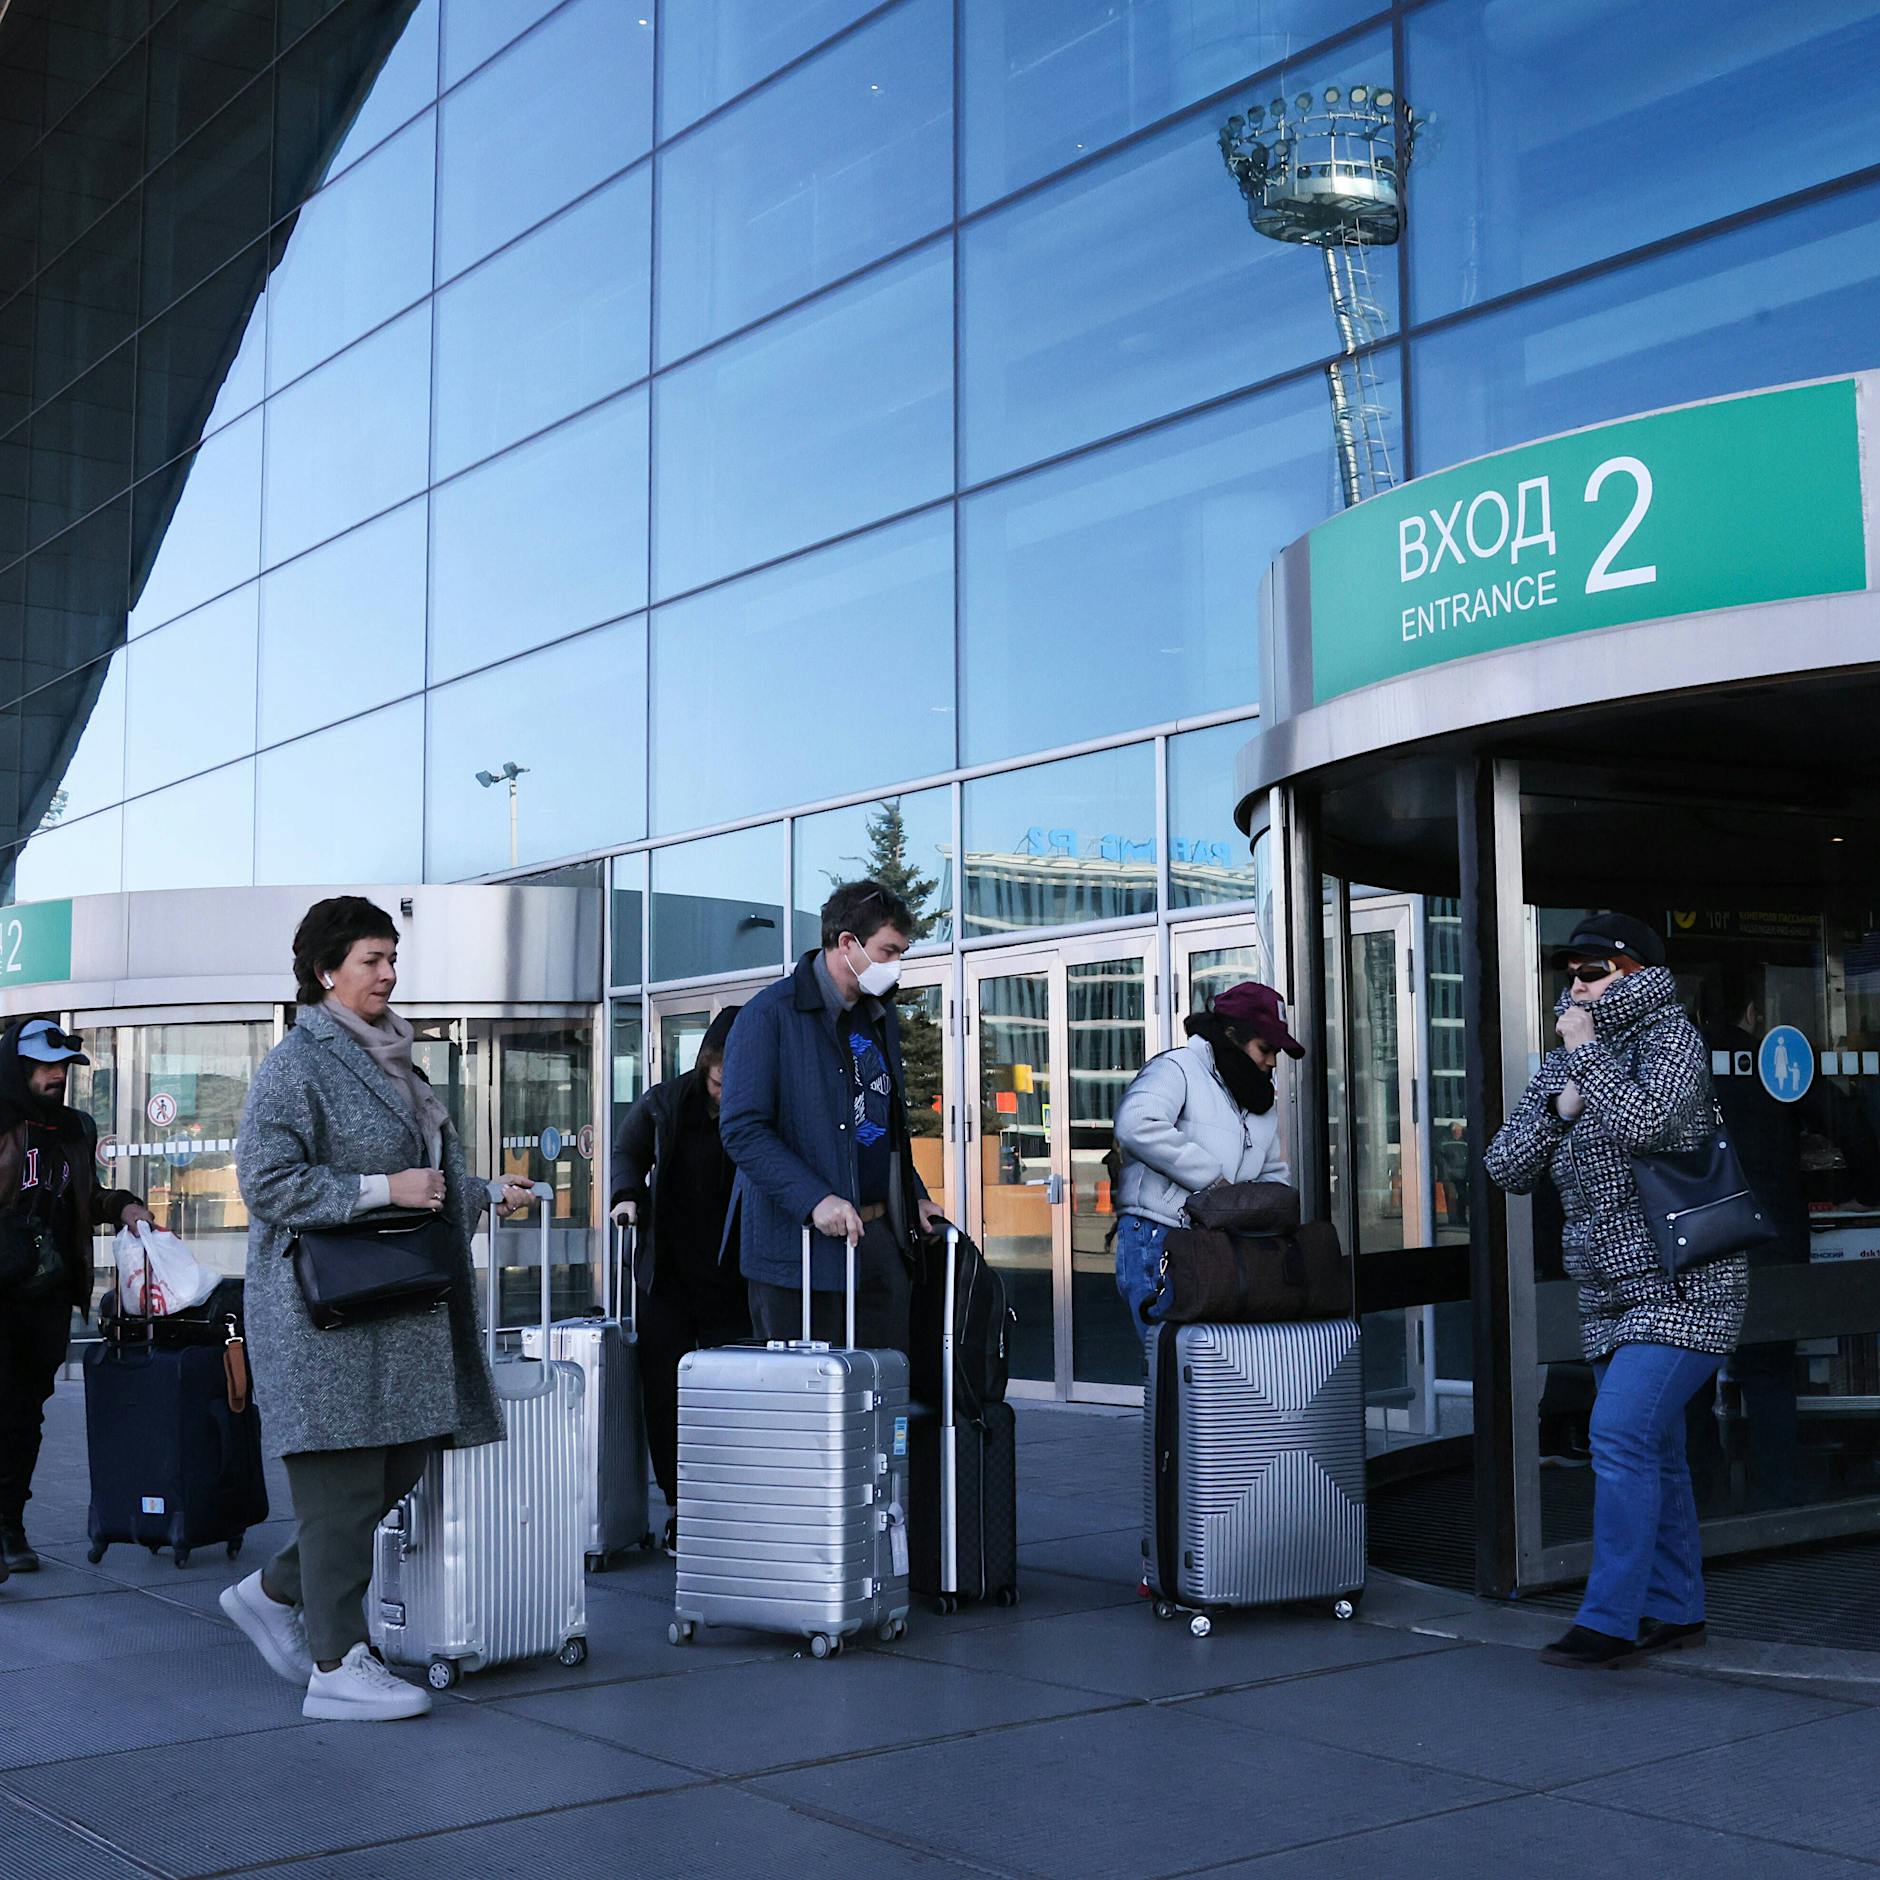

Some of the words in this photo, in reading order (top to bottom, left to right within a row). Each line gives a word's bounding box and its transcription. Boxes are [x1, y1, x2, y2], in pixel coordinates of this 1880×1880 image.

[1399, 476, 1556, 583] ВХОД
[1583, 455, 1657, 595] 2
[1401, 569, 1558, 642] ENTRANCE
[6, 919, 23, 972] 2
